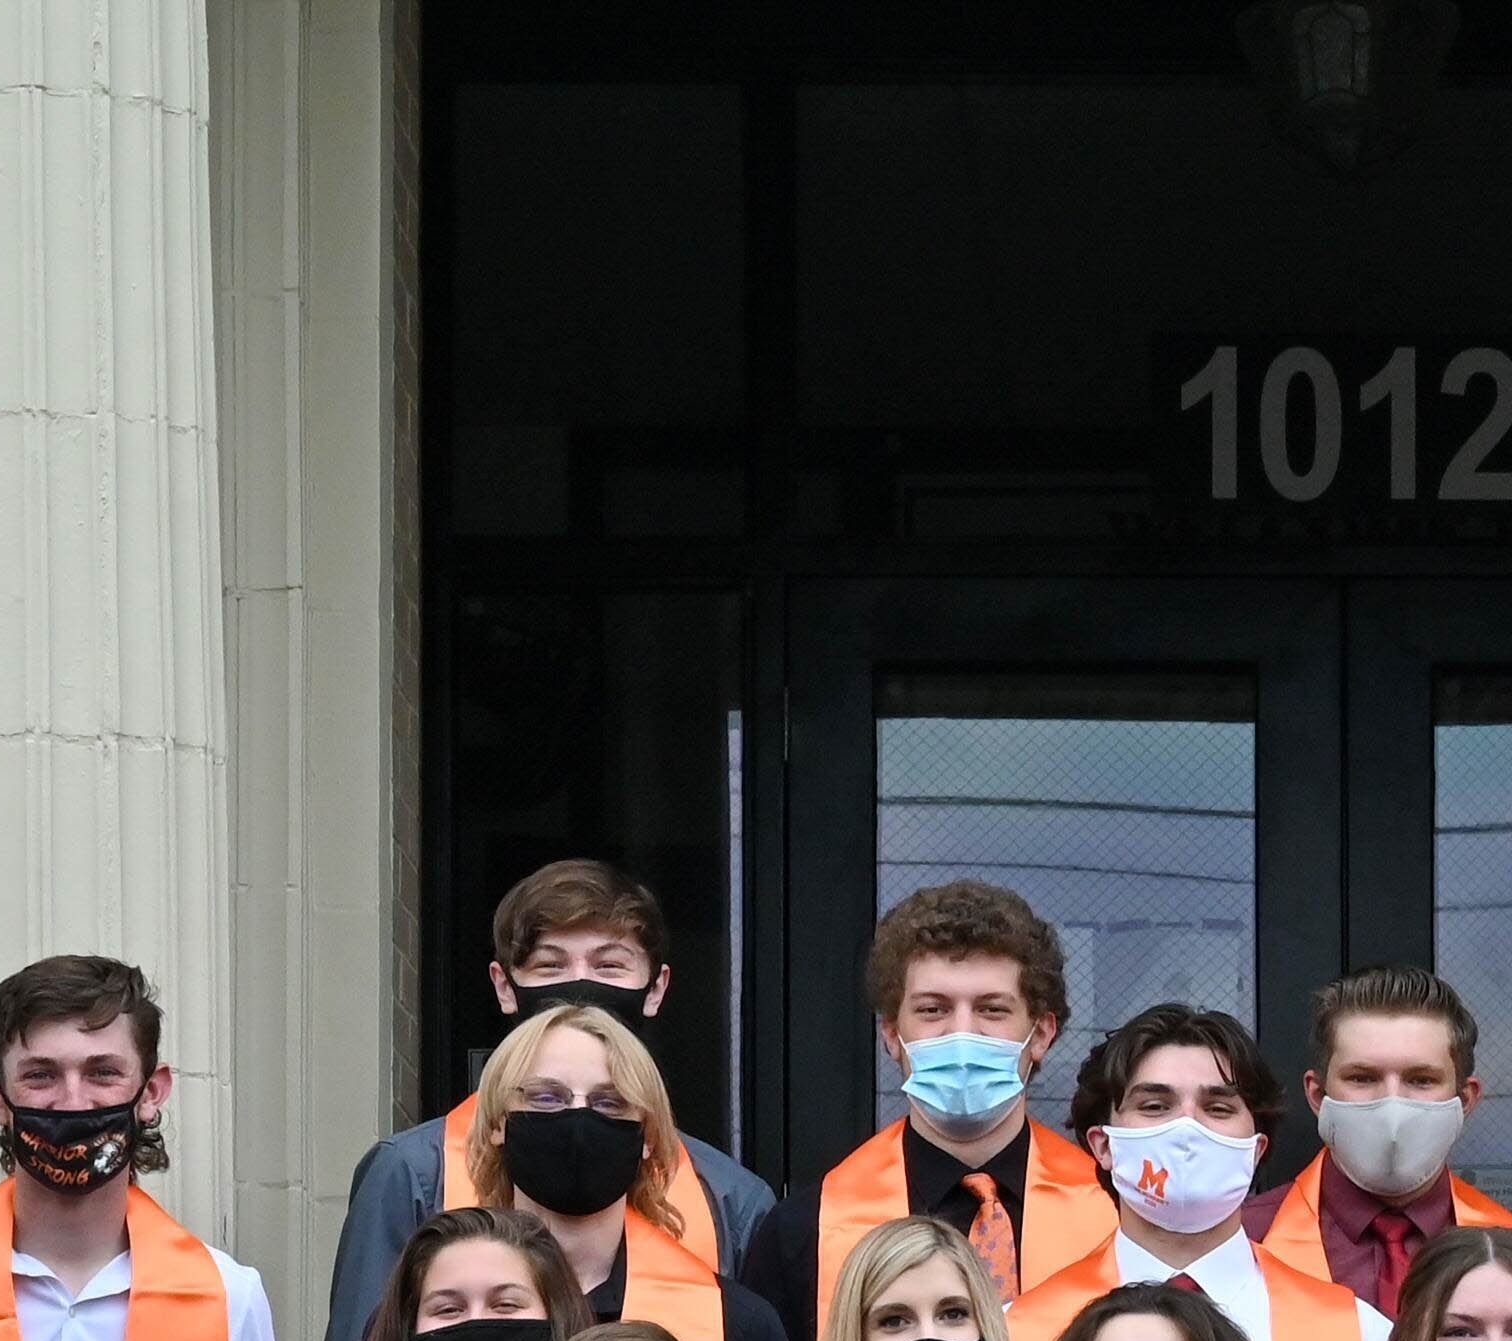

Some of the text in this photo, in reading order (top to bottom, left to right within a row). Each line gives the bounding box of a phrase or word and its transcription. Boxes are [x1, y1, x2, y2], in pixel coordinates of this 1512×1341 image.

[20, 1131, 88, 1160] WARRIOR
[30, 1156, 90, 1185] STRONG
[1138, 1160, 1168, 1198] M
